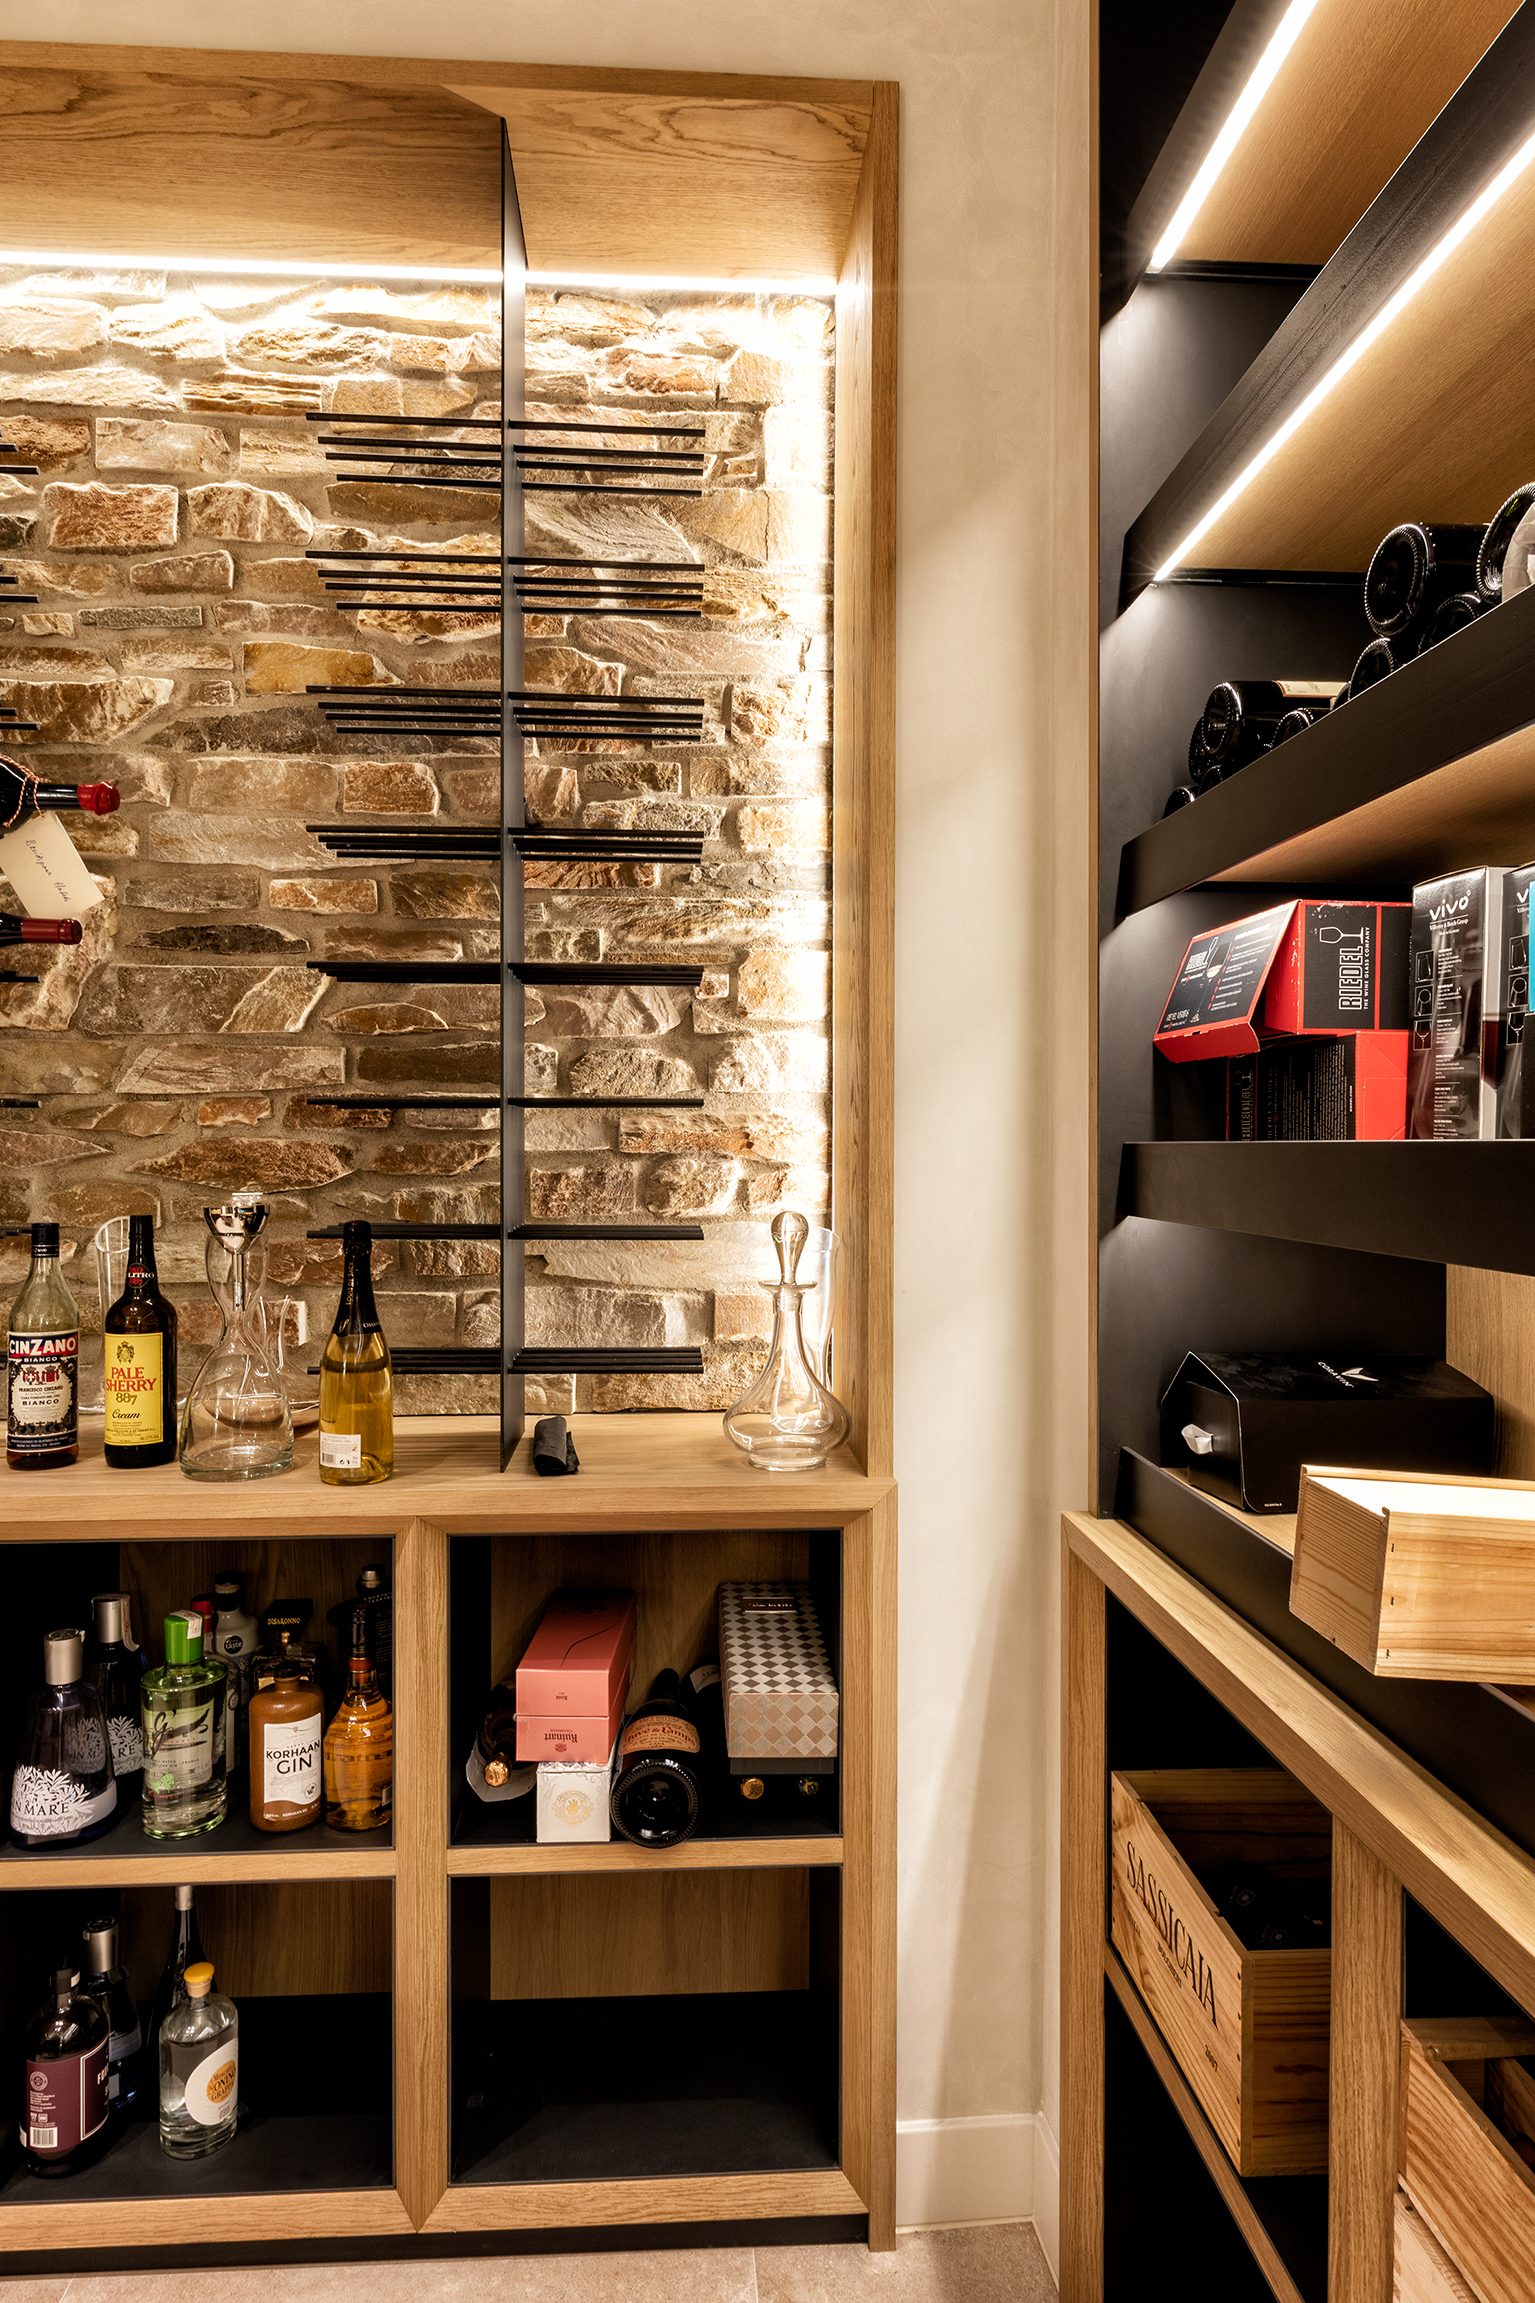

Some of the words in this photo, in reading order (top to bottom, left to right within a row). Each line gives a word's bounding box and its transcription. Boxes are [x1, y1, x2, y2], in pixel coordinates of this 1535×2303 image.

[1429, 895, 1469, 920] vivo
[1339, 945, 1364, 1010] RIEDEL
[9, 1337, 77, 1356] CINZANO
[111, 1366, 145, 1379] PALE
[1317, 1361, 1355, 1388] CORAVIN
[106, 1378, 157, 1392] SHERRY
[22, 1398, 60, 1406] BIANCO
[115, 1393, 138, 1405] 887
[112, 1409, 141, 1419] Cream
[267, 1617, 301, 1626] DISARONNO
[544, 1732, 578, 1744] Ruinart
[266, 1739, 321, 1759] KORHAAN
[276, 1753, 312, 1774] GIN
[24, 1801, 70, 1816] MARE
[1127, 1840, 1219, 2031] SASSICAIA
